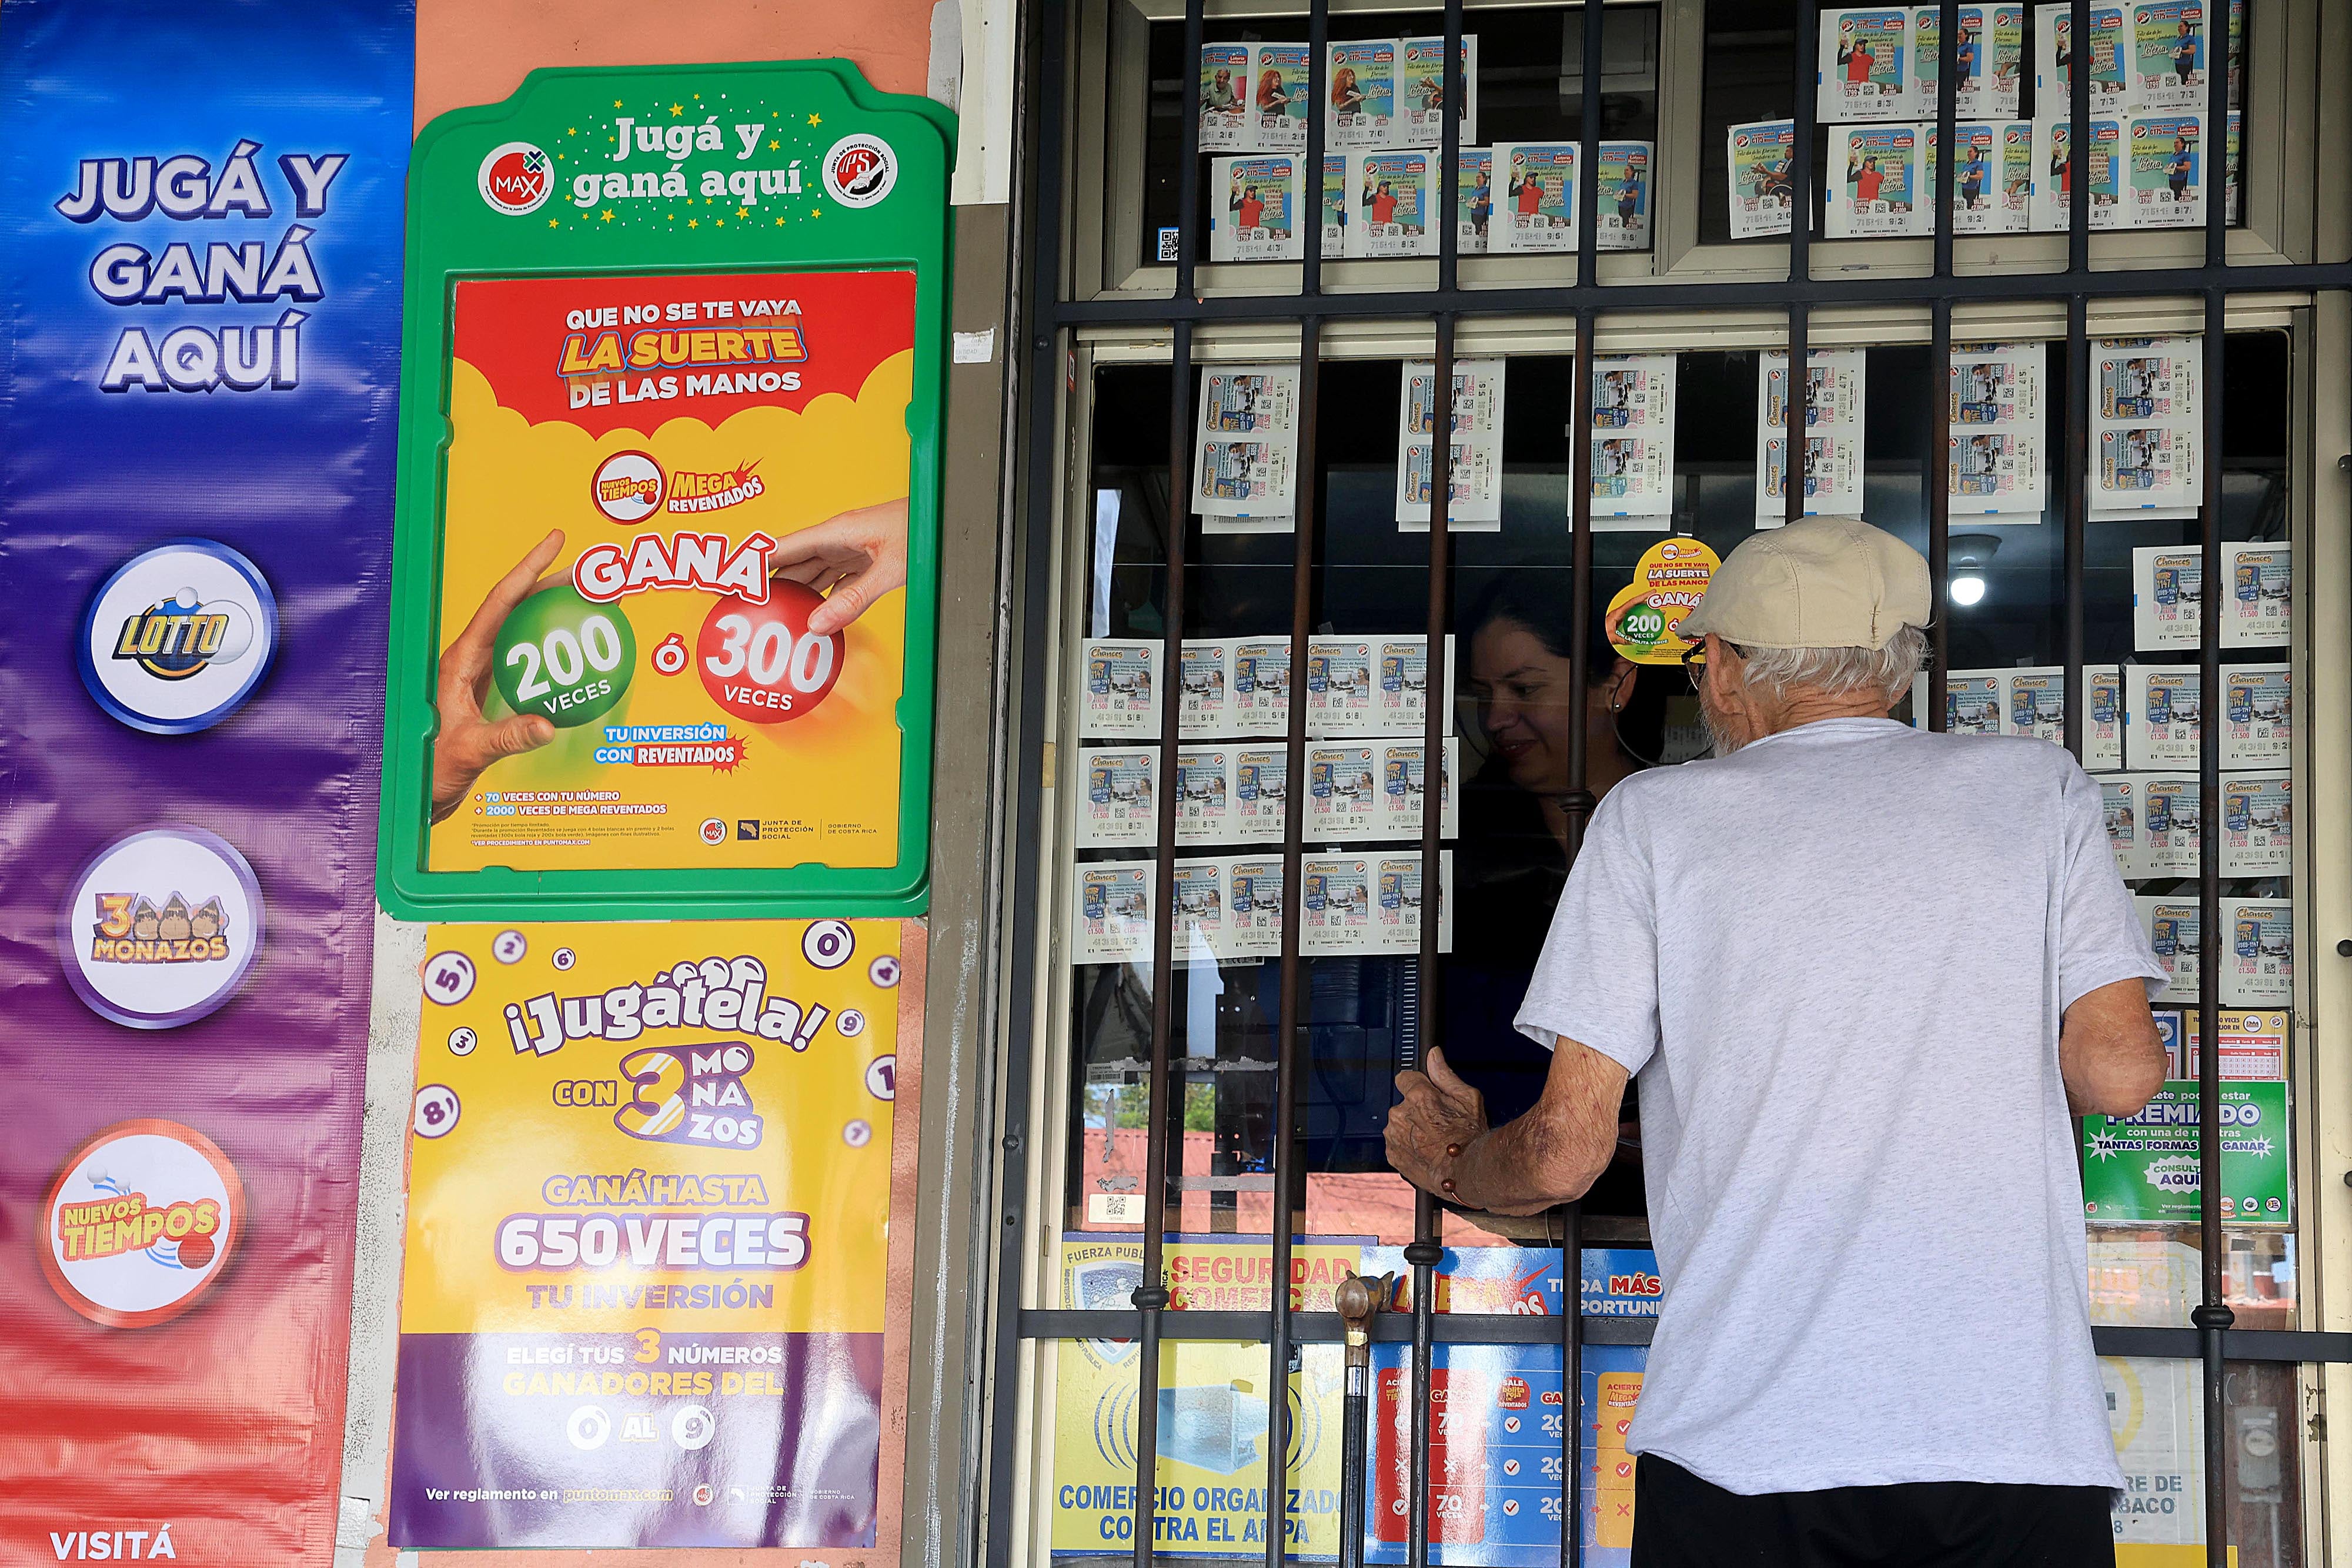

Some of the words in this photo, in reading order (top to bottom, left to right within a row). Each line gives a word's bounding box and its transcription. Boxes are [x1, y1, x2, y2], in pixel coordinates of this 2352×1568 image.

[1845, 89, 1857, 97] 4799
[613, 116, 723, 162] Jugá
[735, 123, 764, 161] y
[831, 156, 840, 174] JUNTA
[846, 143, 881, 155] PROTECCIÓN
[880, 153, 889, 173] SOCIAL
[839, 152, 870, 173] JPS
[55, 139, 272, 223] JUGÁ
[277, 154, 350, 218] Y
[496, 175, 540, 198] MAX
[572, 163, 688, 207] ganá
[700, 160, 802, 205] aquí
[89, 224, 325, 306] GANÁ
[566, 308, 618, 330] QUE
[623, 303, 660, 326] NO
[665, 302, 697, 320] SE
[702, 300, 734, 319] TE
[738, 299, 802, 317] VAYA
[99, 307, 311, 394] AQUÍ
[560, 333, 626, 375] LA
[627, 328, 806, 366] SUERTE
[569, 381, 611, 409] DE
[618, 376, 679, 403] LAS
[686, 372, 801, 396] MANOS
[601, 478, 631, 490] NUEVOS
[601, 479, 657, 502] TIEMPOS
[668, 476, 763, 511] REVENTADOS
[671, 472, 739, 498] MEGA
[575, 533, 776, 603] GANÁ
[2155, 555, 2191, 567] Chances
[1648, 569, 1665, 579] LA
[1665, 569, 1709, 579] SUERTE
[1648, 592, 1704, 609] GANÁ
[1627, 615, 1661, 632] 200
[112, 614, 229, 660] LOTTO
[506, 615, 622, 703] 200
[706, 614, 834, 694] 300
[1090, 647, 1124, 658] Chances
[1309, 644, 1342, 656] Chances
[2149, 674, 2184, 686] Chances
[543, 679, 612, 715] VECES
[723, 684, 793, 711] VECES
[605, 726, 629, 741] TU
[633, 721, 726, 741] INVERSIÓN
[595, 747, 633, 764] CON
[637, 745, 735, 765] REVENTADOS
[485, 794, 500, 803] 70
[503, 792, 534, 803] VECES
[536, 791, 559, 802] CON
[560, 791, 574, 801] TU
[576, 790, 620, 801] NÚMERO
[486, 805, 515, 816] 2000
[519, 805, 551, 816] VECES
[553, 805, 566, 815] DE
[568, 805, 597, 815] MEGA
[600, 804, 667, 815] REVENTADOS
[706, 828, 722, 839] MAX
[100, 895, 132, 938] 3
[2154, 906, 2191, 919] Chances
[92, 935, 229, 962] MONAZOS
[503, 974, 828, 1057] ¡Jugátela!
[553, 1079, 617, 1107] CON
[614, 1052, 686, 1138] 3
[2221, 1092, 2250, 1101] estar
[2127, 1129, 2147, 1137] con
[2174, 1128, 2190, 1137] de
[2097, 1140, 2142, 1151] TANTAS
[2147, 1140, 2198, 1151] FORMAS
[2221, 1141, 2266, 1151] GANAR
[543, 1169, 649, 1206] GANÁ
[650, 1175, 769, 1205] HASTA
[65, 1197, 142, 1225] NUEVOS
[63, 1204, 216, 1258] TIEMPOS
[497, 1215, 621, 1269] 650
[623, 1215, 808, 1269] VECES
[1067, 1246, 1112, 1263] FUERZA
[526, 1285, 573, 1309] TU
[582, 1278, 774, 1309] INVERSIÓN
[1610, 1271, 1662, 1296] MÁS
[506, 1343, 574, 1364] ELEGÍ
[579, 1347, 624, 1364] TUS
[633, 1328, 662, 1363] 3
[668, 1343, 783, 1364] NÚMEROS
[502, 1371, 713, 1396] GANADORES
[721, 1373, 783, 1396] DEL
[1611, 1391, 1633, 1401] MEGA
[621, 1415, 659, 1440] AL
[426, 1488, 450, 1500] Ver
[453, 1488, 537, 1502] reglamento
[540, 1490, 558, 1500] en
[563, 1489, 674, 1503] puntomax.com
[2156, 1476, 2182, 1492] DE
[1436, 1495, 1462, 1511] 70
[1100, 1515, 1199, 1542] COTRA
[1207, 1518, 1235, 1542] EL
[49, 1523, 176, 1560] VISITÁ
